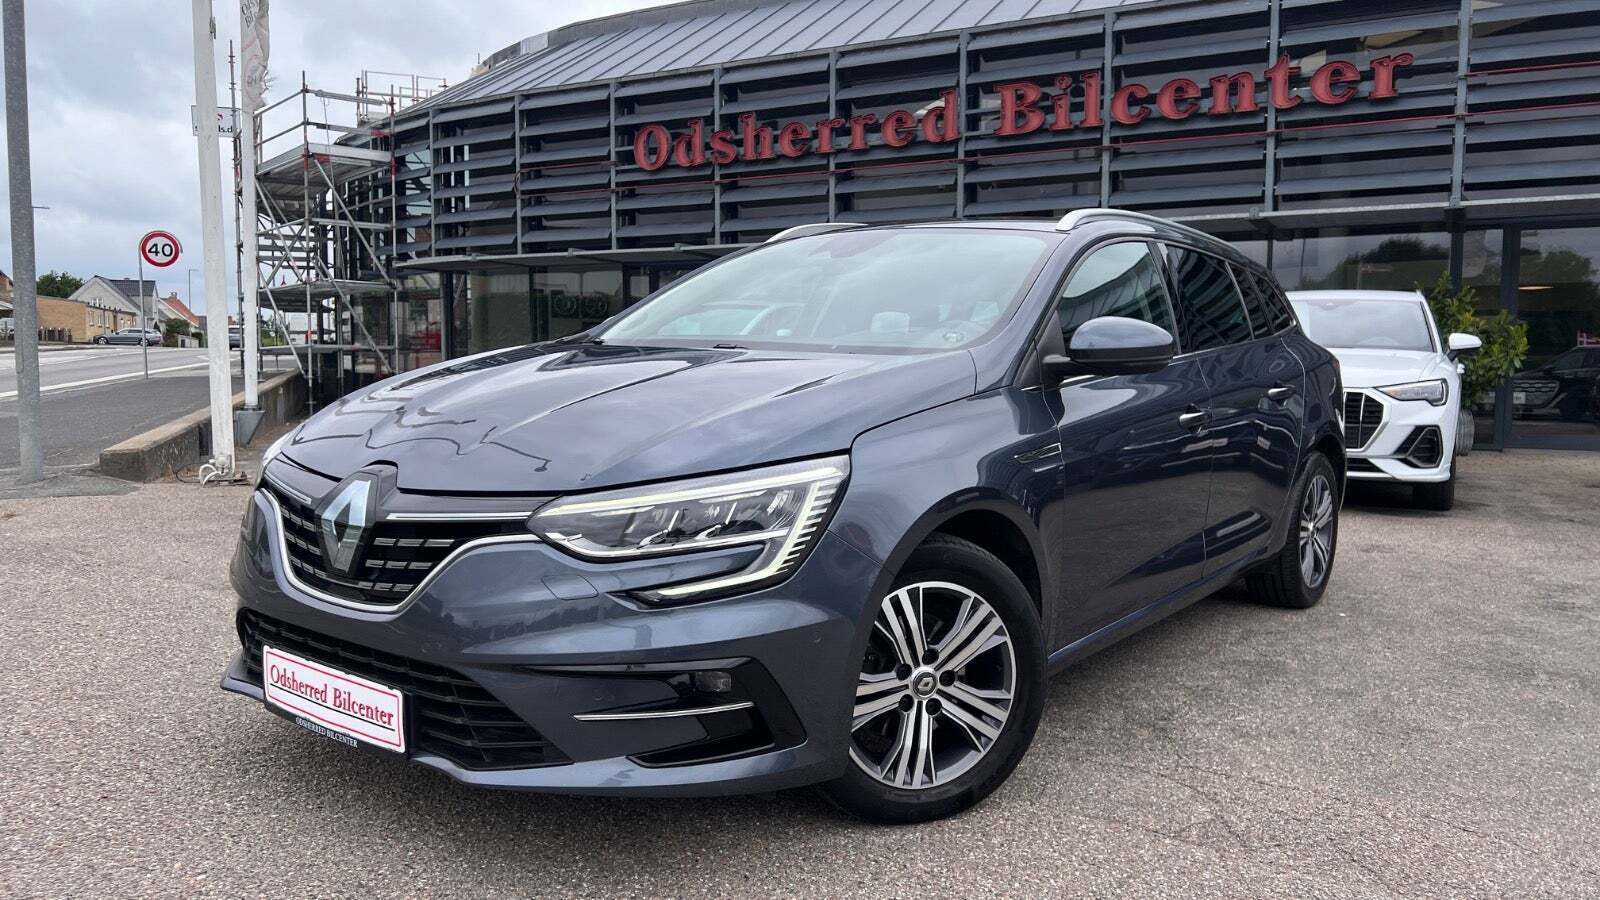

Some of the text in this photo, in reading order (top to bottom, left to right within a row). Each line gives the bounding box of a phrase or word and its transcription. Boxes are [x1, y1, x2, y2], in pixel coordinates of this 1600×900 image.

[633, 52, 1415, 171] Odsherred Bilcenter
[148, 242, 173, 257] 40
[270, 665, 394, 727] Odsherred Bilcenter
[295, 716, 358, 748] ODSHERRED BILCENTER
